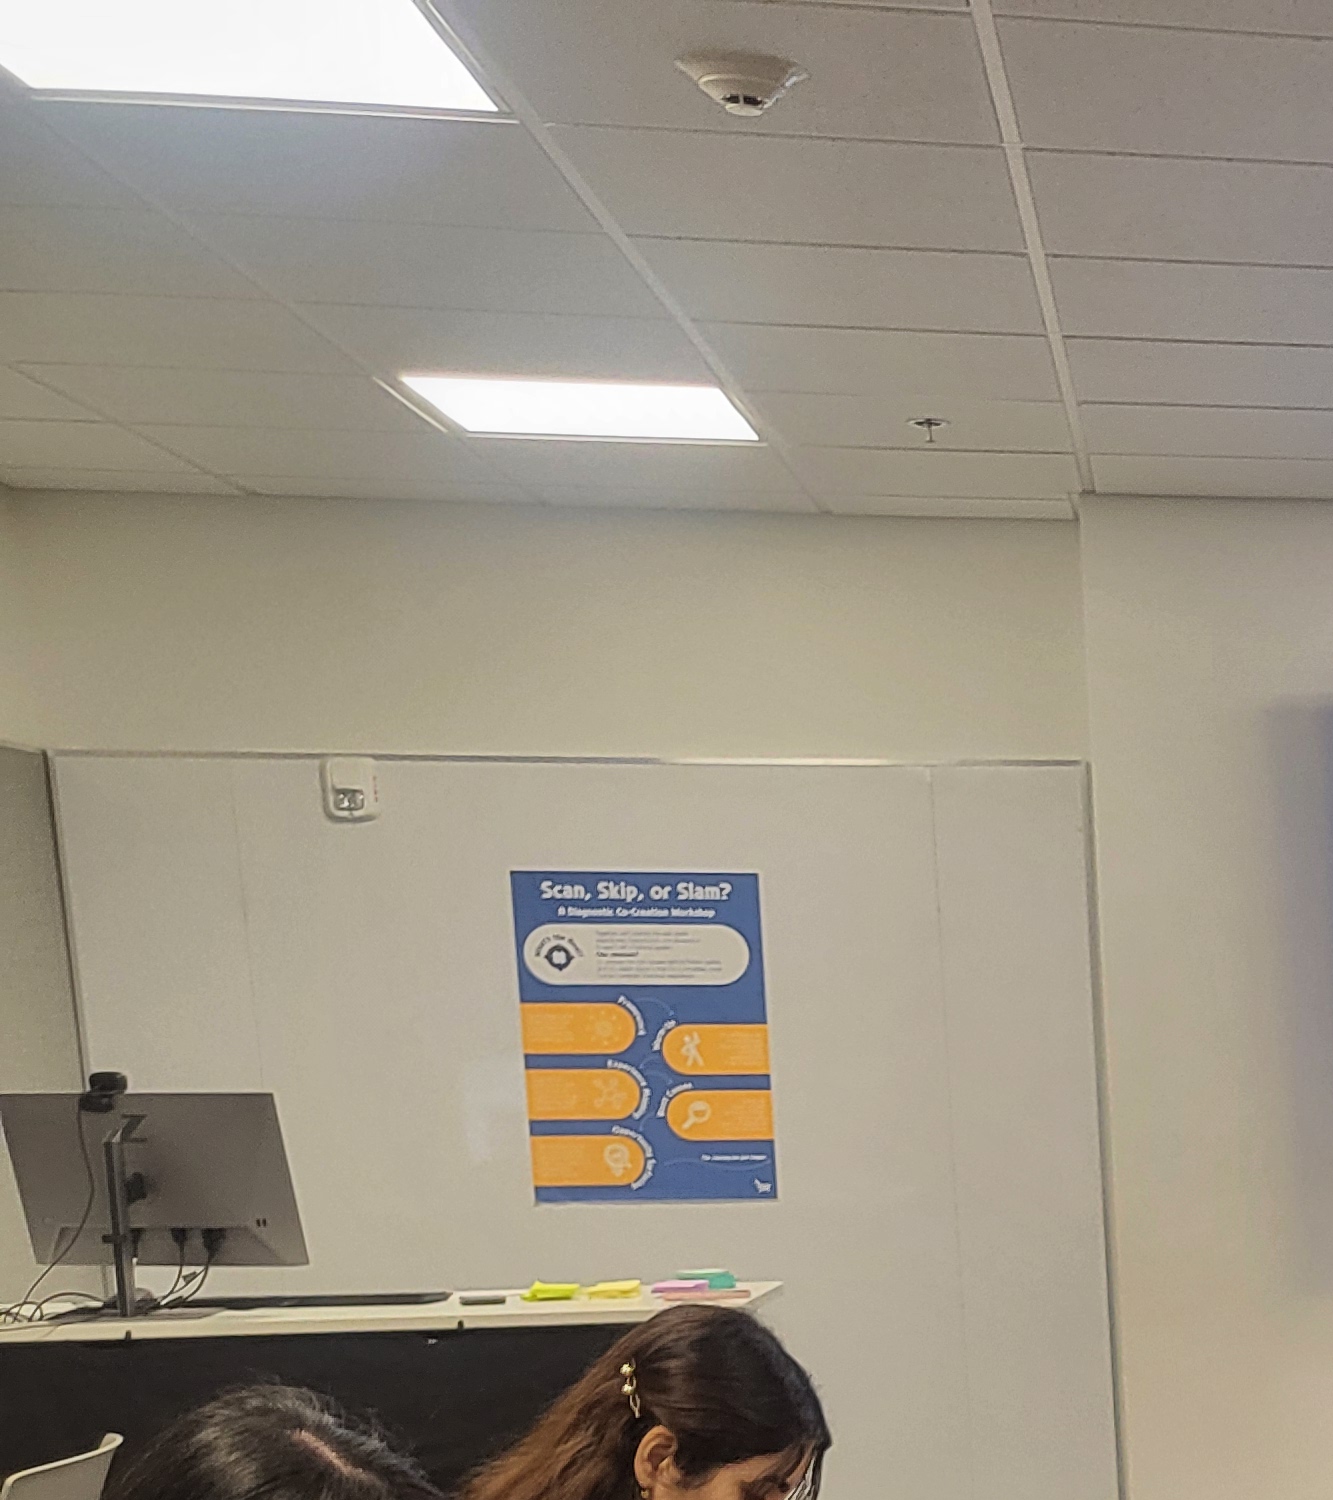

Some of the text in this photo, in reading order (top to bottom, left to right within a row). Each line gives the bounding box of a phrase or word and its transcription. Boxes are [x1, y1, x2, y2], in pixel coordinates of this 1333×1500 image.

[539, 880, 733, 903] Scan, Skip, or Slam?
